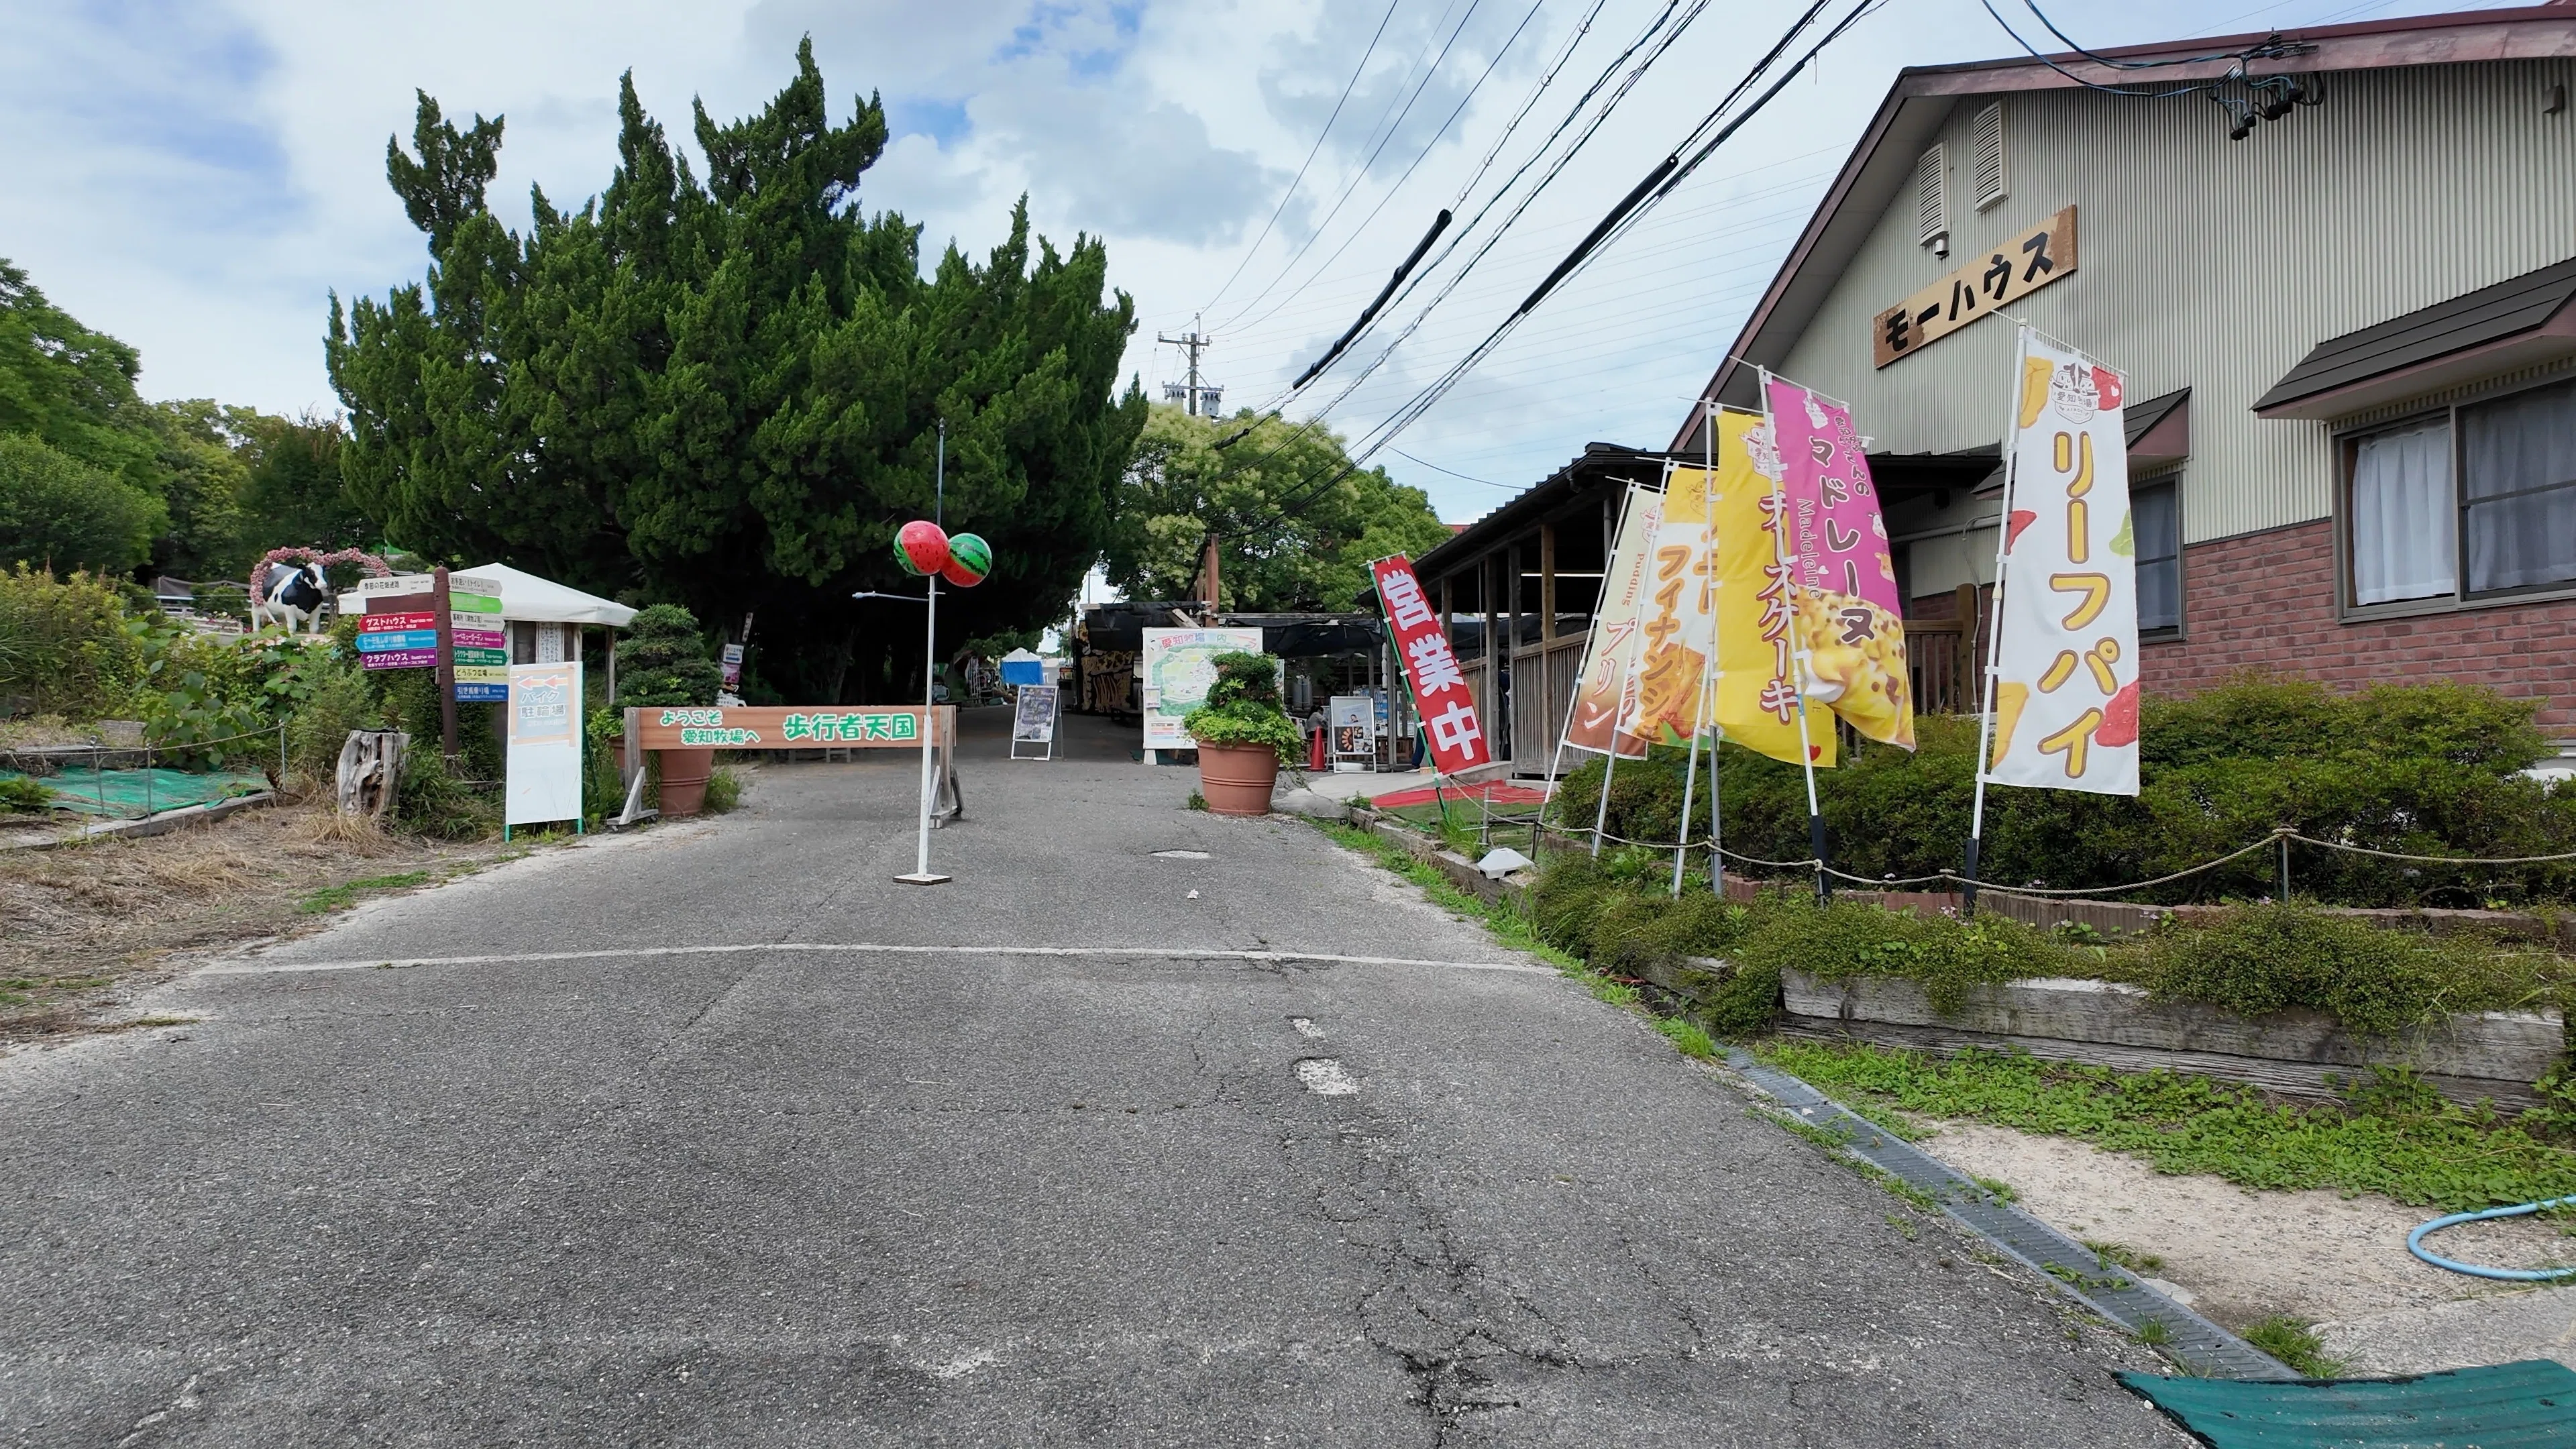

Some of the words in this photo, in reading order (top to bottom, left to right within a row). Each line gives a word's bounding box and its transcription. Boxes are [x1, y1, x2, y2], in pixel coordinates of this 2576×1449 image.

[1886, 231, 2053, 352] モーハウス
[1796, 498, 1821, 598] Madeleine
[1809, 435, 1876, 644] マドレーヌ
[1622, 553, 1645, 606] Pudding
[366, 617, 406, 627] ゲストハウス
[2037, 431, 2122, 780] リーフパイ
[366, 653, 408, 663] クラブハウス
[1381, 568, 1482, 761] 営業中
[1584, 617, 1640, 730] プリン
[521, 690, 559, 703] バイク
[521, 704, 565, 718] 駐輪場
[659, 709, 723, 727] ようこそ
[680, 729, 761, 745] 愛知牧場へ
[784, 712, 917, 741] 歩行者天国
